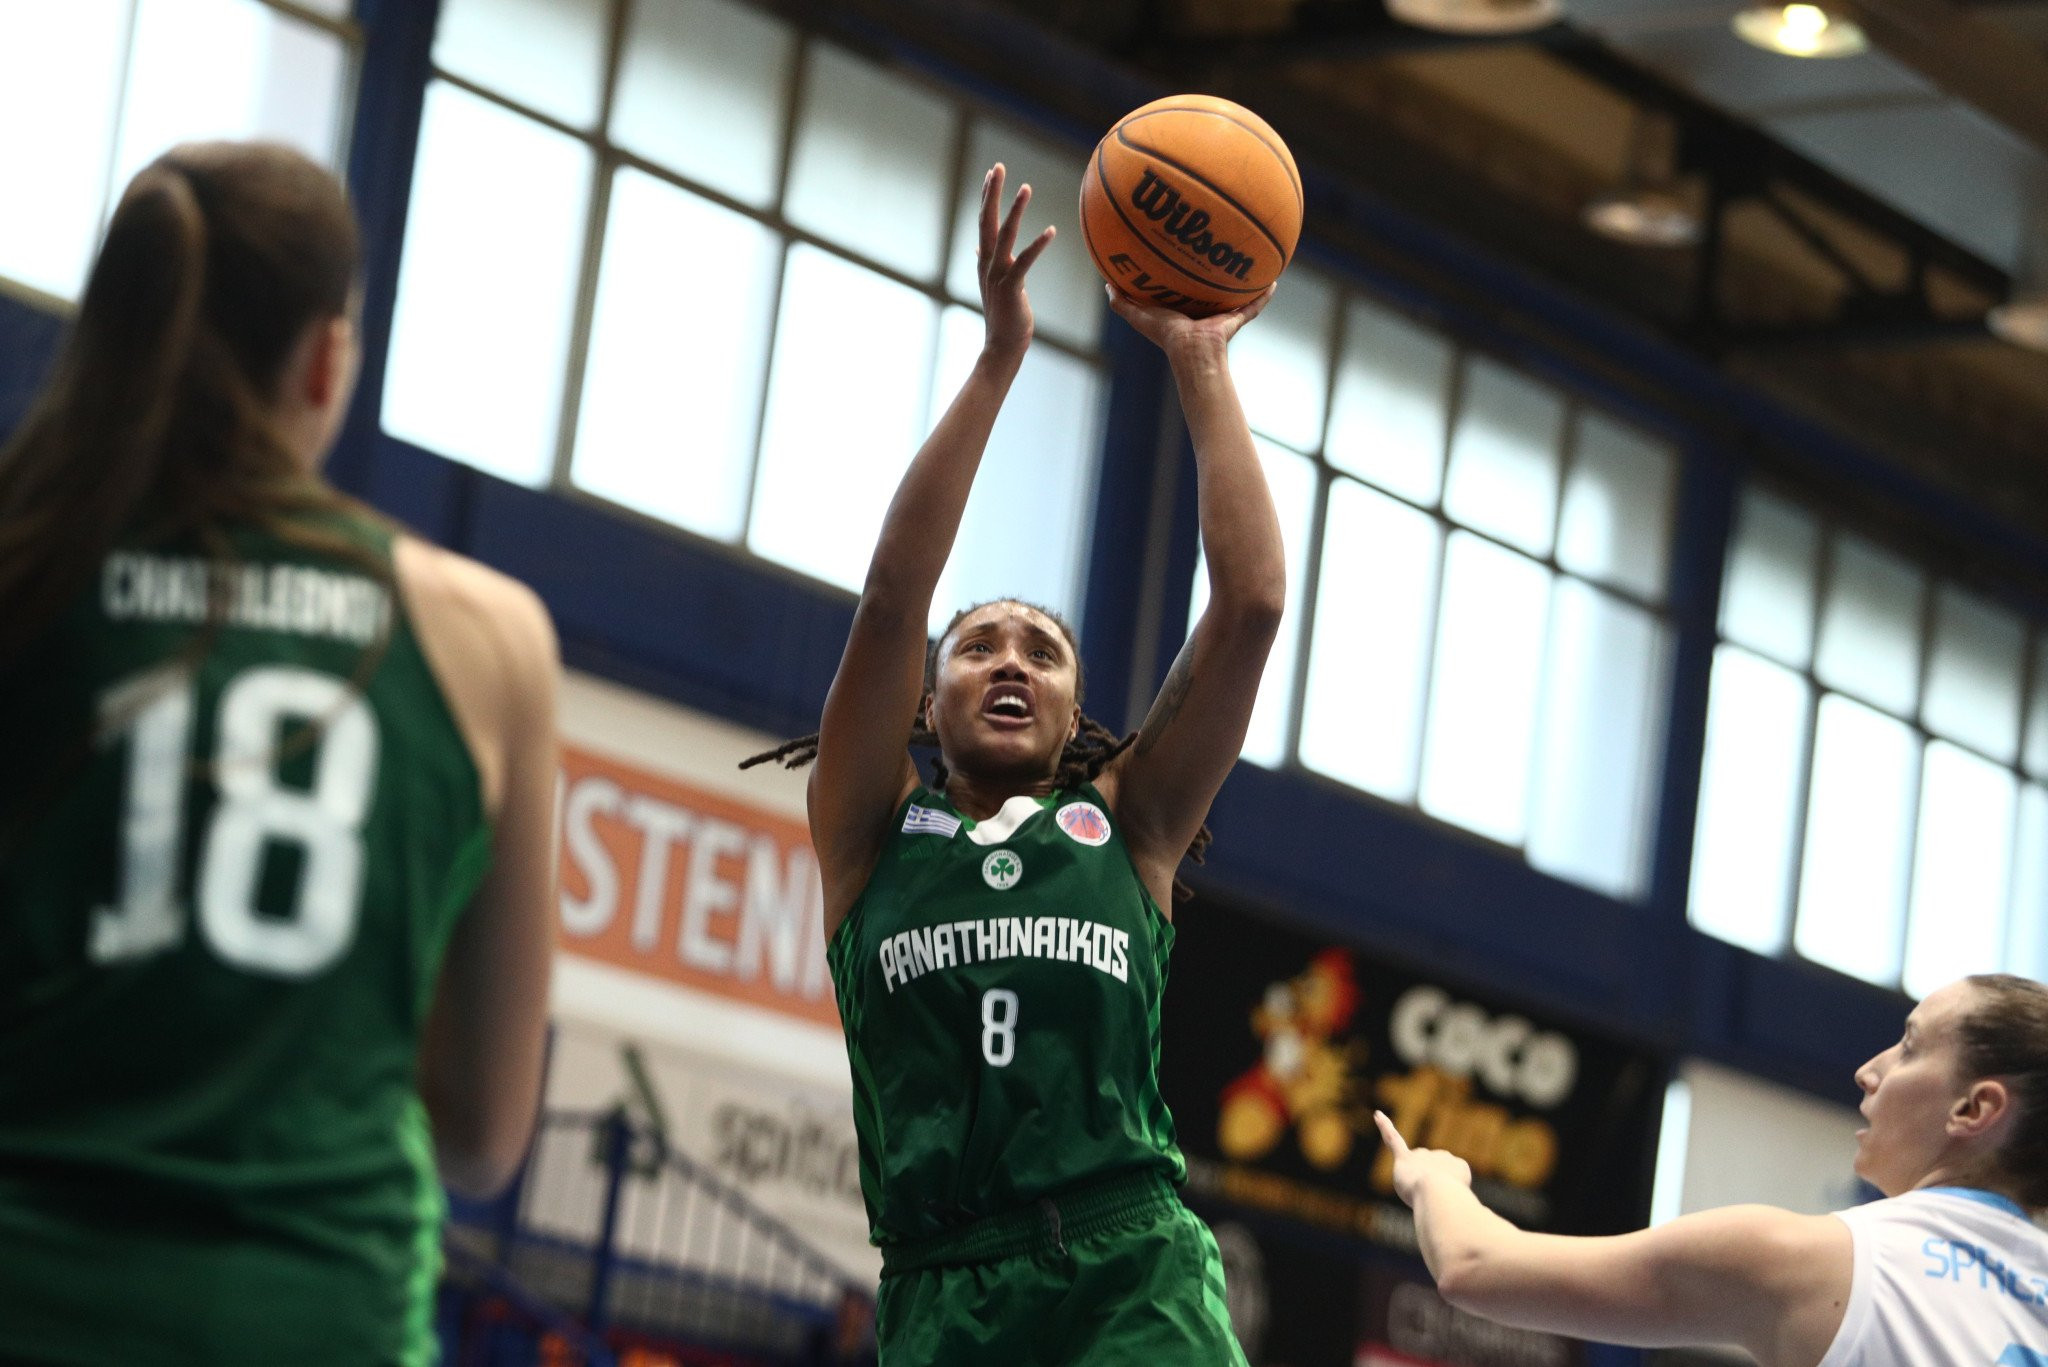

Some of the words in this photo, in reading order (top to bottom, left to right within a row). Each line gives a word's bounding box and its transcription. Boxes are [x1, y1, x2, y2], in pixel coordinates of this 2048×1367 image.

[1131, 168, 1255, 280] Wilson
[88, 664, 381, 980] 18
[879, 917, 1129, 994] PANATHINAIKOS
[981, 988, 1019, 1067] 8
